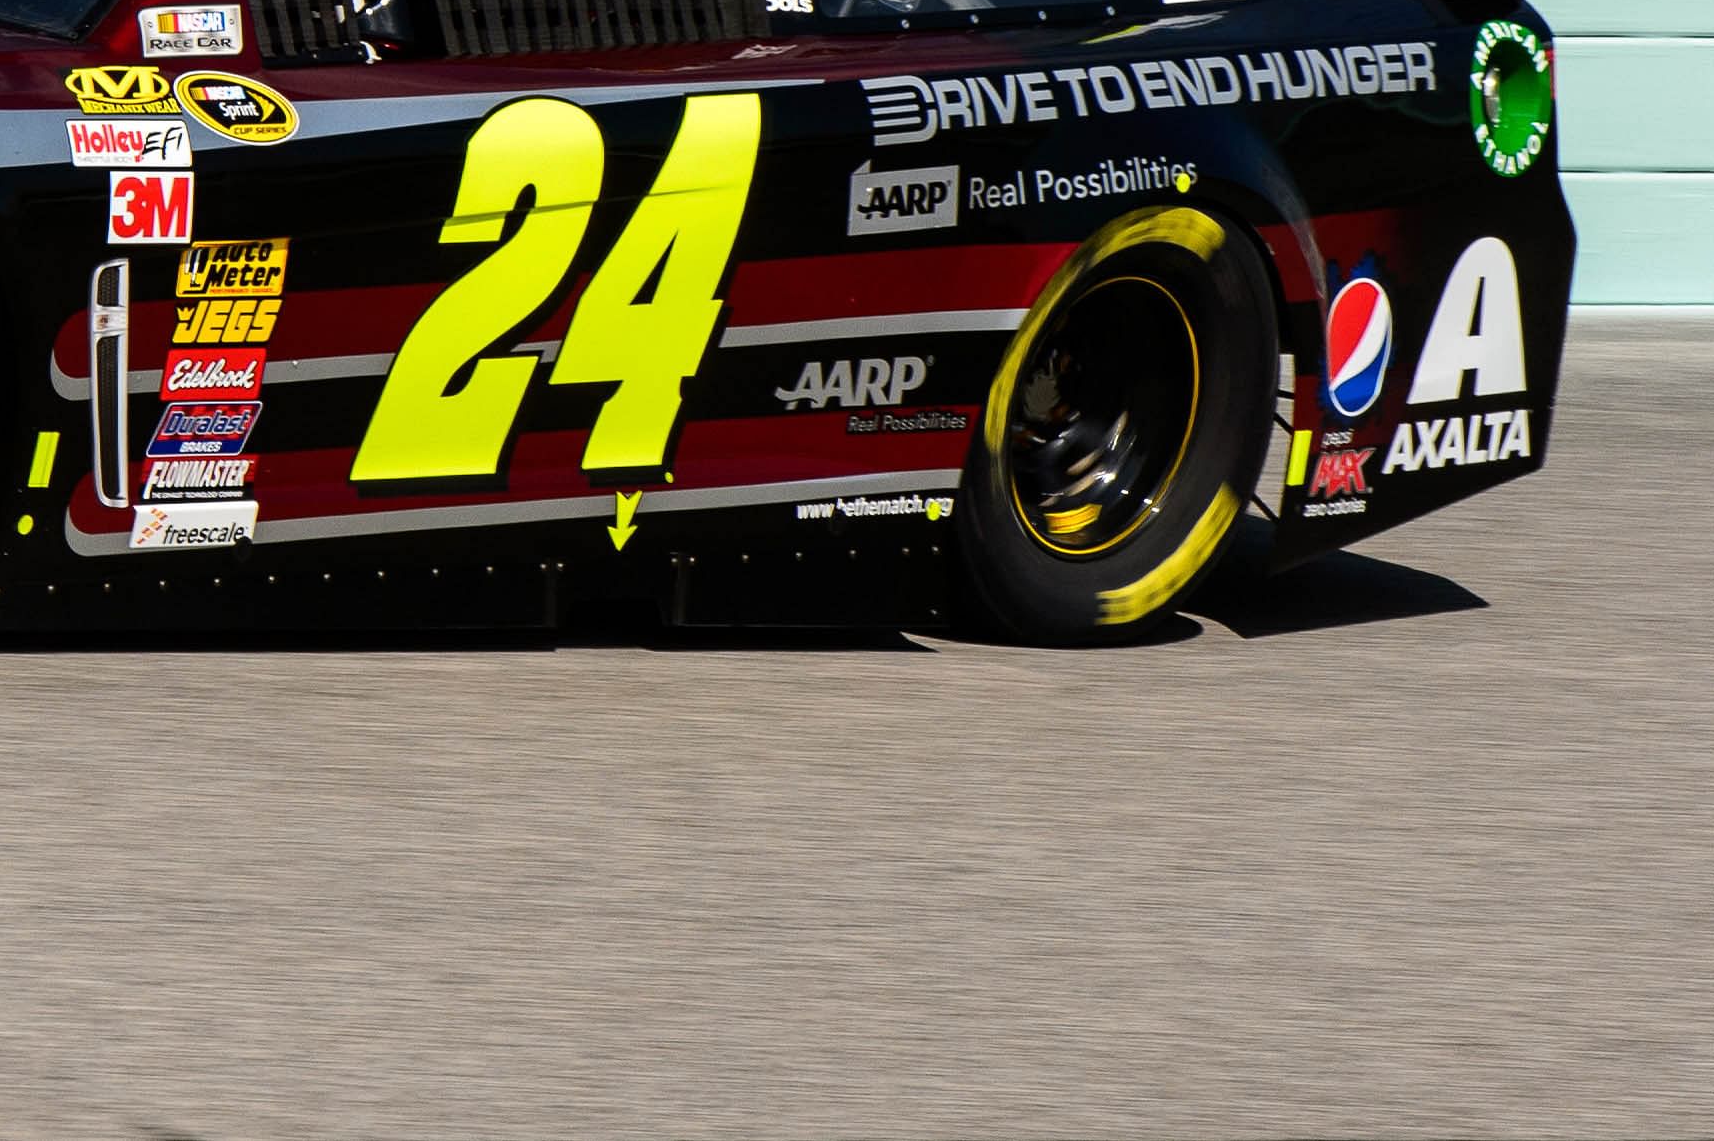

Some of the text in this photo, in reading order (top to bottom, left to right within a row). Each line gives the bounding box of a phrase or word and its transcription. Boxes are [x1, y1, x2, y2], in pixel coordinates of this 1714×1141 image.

[178, 12, 226, 33] NASCAR
[150, 36, 232, 50] RACE CAR
[1470, 22, 1549, 91] AMERICAN
[81, 97, 183, 115] MECHANIX WEAR
[205, 86, 247, 101] NASCAR
[859, 42, 1436, 146] DRIVE TO END HUNGER
[219, 102, 260, 121] Sprint
[72, 124, 184, 161] Holley EFI
[234, 126, 287, 135] CUP SERIES
[1474, 122, 1550, 174] ETHANOL
[857, 156, 1198, 220] AARP Real Possibilities
[112, 176, 191, 238] 3M
[207, 264, 282, 288] Meter
[350, 92, 762, 481] 24
[172, 299, 283, 344] JEGS
[167, 358, 258, 391] Edelbrock
[774, 356, 927, 411] AARP
[161, 409, 254, 436] Duralast
[847, 412, 967, 432] Real Possibilities
[179, 441, 223, 453] BRAKES
[1381, 410, 1532, 475] AXALTA
[142, 459, 250, 500] FLOWMASTER
[162, 522, 245, 545] freescale
